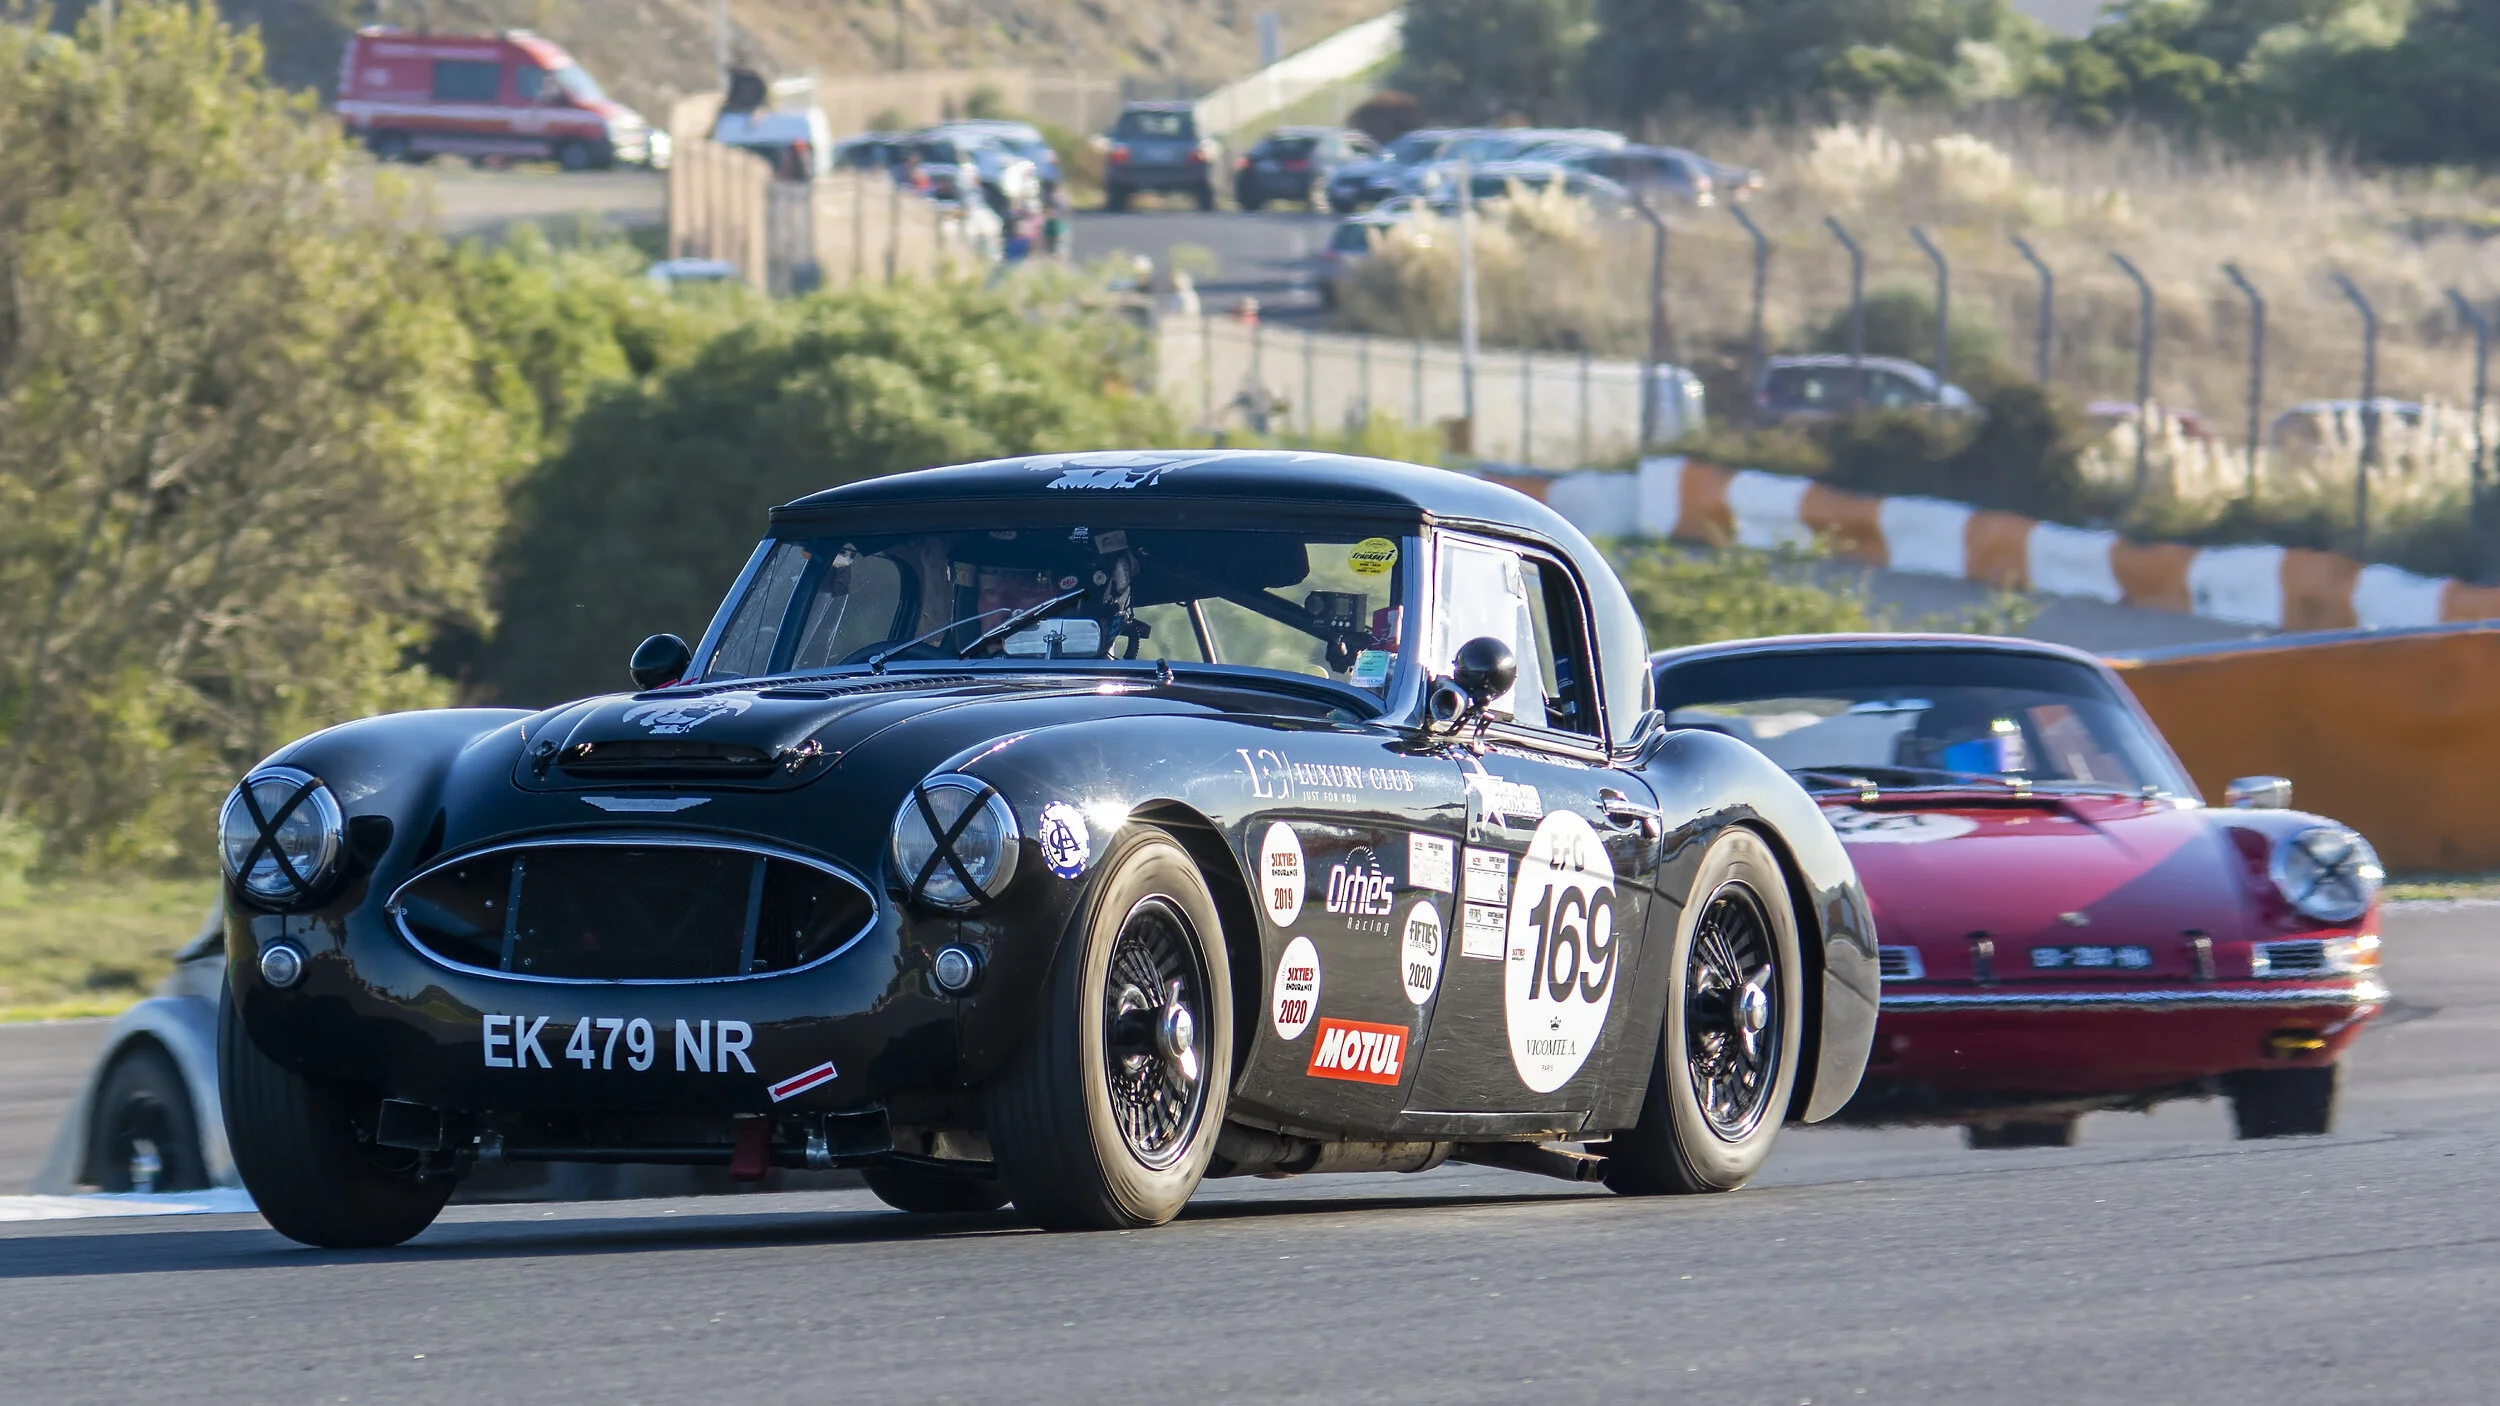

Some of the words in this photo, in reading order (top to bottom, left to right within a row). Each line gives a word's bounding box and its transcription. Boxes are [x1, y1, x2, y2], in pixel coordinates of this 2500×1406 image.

[1294, 763, 1364, 788] LUXURY
[1369, 767, 1414, 792] CLUB
[1303, 791, 1319, 802] JUST
[1324, 792, 1339, 803] FOR
[1342, 793, 1357, 804] YOU
[1271, 853, 1297, 867] SIXTIES
[1271, 869, 1298, 877] ENDURANCE
[1274, 888, 1293, 910] 2019
[1347, 916, 1390, 937] Racing
[1409, 919, 1438, 957] FIFTIES
[1529, 884, 1618, 1004] 169
[1286, 967, 1314, 982] SIXTIES
[1407, 962, 1433, 991] 2020
[1285, 983, 1313, 992] ENDURANCE
[1278, 999, 1308, 1024] 2020
[483, 1014, 552, 1069] EK
[565, 1016, 655, 1072] 479
[675, 1018, 757, 1073] NR
[1314, 1027, 1400, 1075] MOTUL
[1526, 1039, 1567, 1056] VICOMTE
